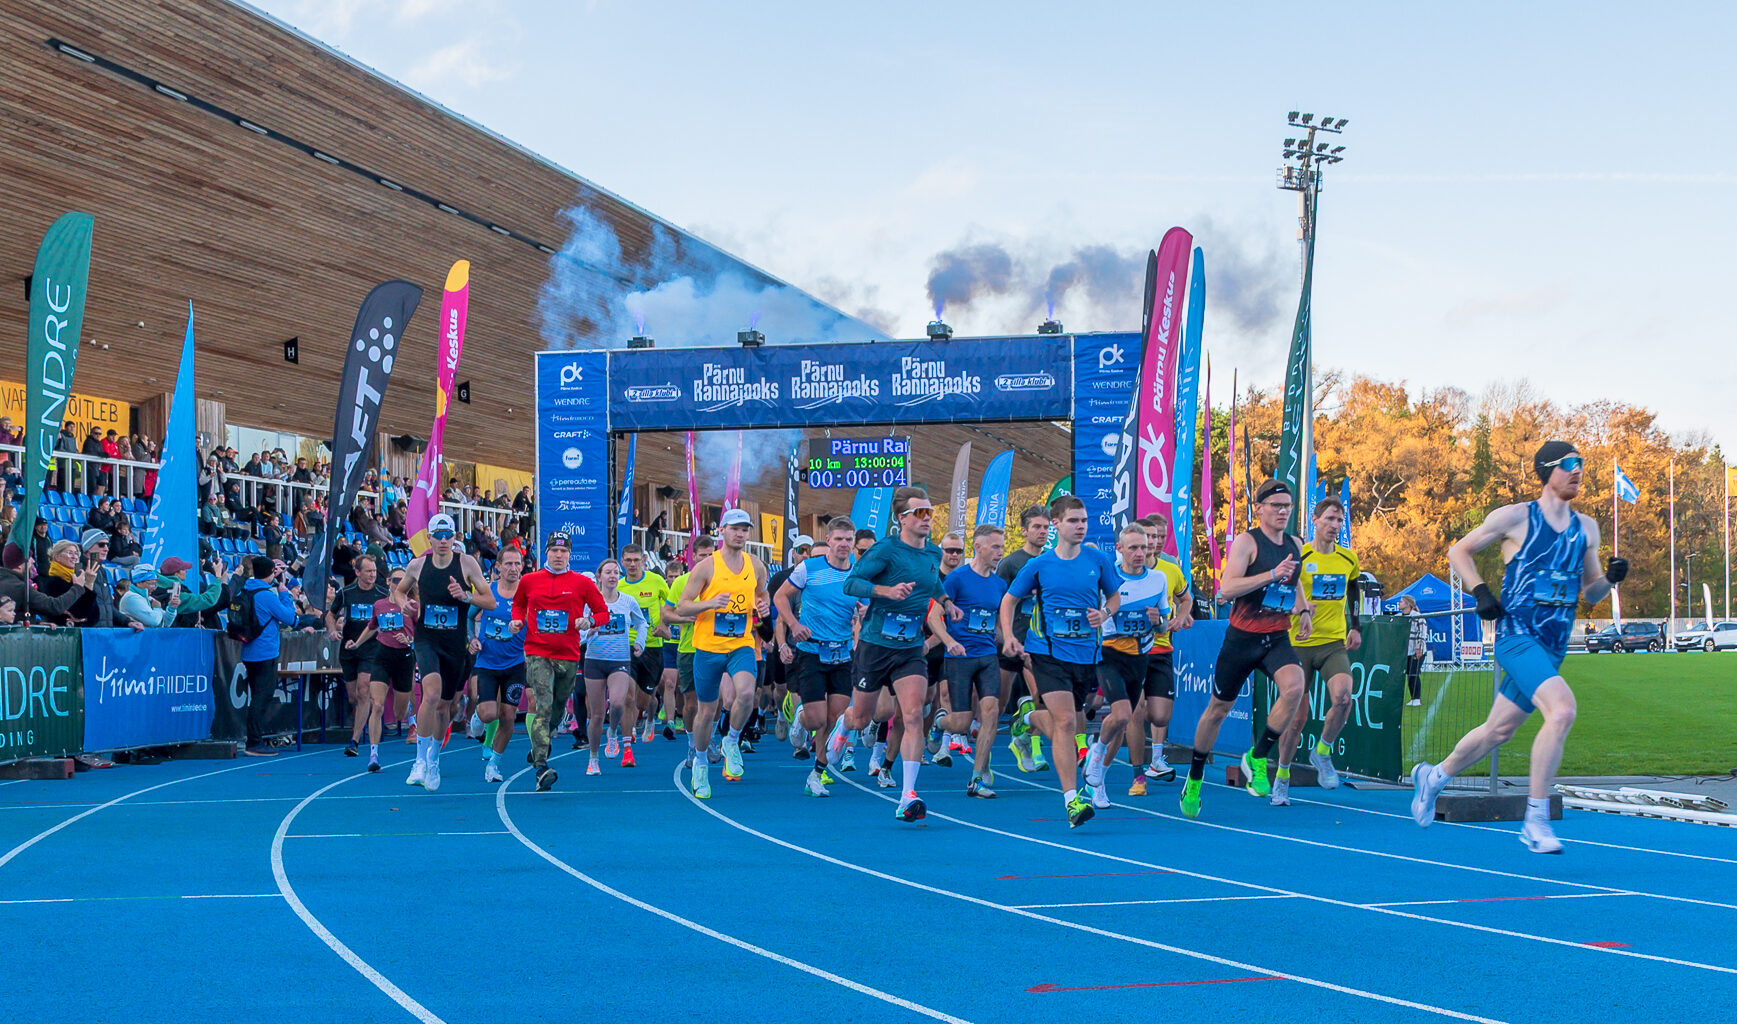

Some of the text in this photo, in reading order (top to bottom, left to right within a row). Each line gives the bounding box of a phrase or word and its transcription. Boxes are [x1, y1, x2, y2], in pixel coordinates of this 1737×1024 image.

[447, 309, 459, 372] Keskus
[1153, 271, 1175, 414] Pärnu Keskus
[703, 363, 745, 385] Pärnu
[801, 360, 844, 382] Pärnu
[902, 357, 944, 379] Pärnu
[39, 278, 71, 488] ENDRE
[792, 372, 879, 403] Rannajooks
[892, 371, 981, 400] Rannajooks
[694, 377, 779, 407] Rannajooks
[68, 394, 119, 422] ÕITLEB
[553, 431, 583, 439] CRAFT
[832, 440, 879, 455] Pärnu
[809, 456, 904, 469] 10 km 13:00:04
[810, 468, 907, 488] 00:00:04
[987, 493, 1000, 525] TONIA
[1323, 583, 1337, 594] 23
[1551, 584, 1567, 599] 74
[1279, 596, 1285, 606] 1
[434, 614, 448, 624] 10
[544, 618, 559, 628] 55
[981, 618, 987, 628] 6
[1065, 619, 1081, 632] 18
[1123, 620, 1146, 632] 533
[495, 626, 502, 635] 9
[727, 622, 735, 632] 3
[898, 624, 906, 635] 2
[1424, 629, 1447, 642] aku
